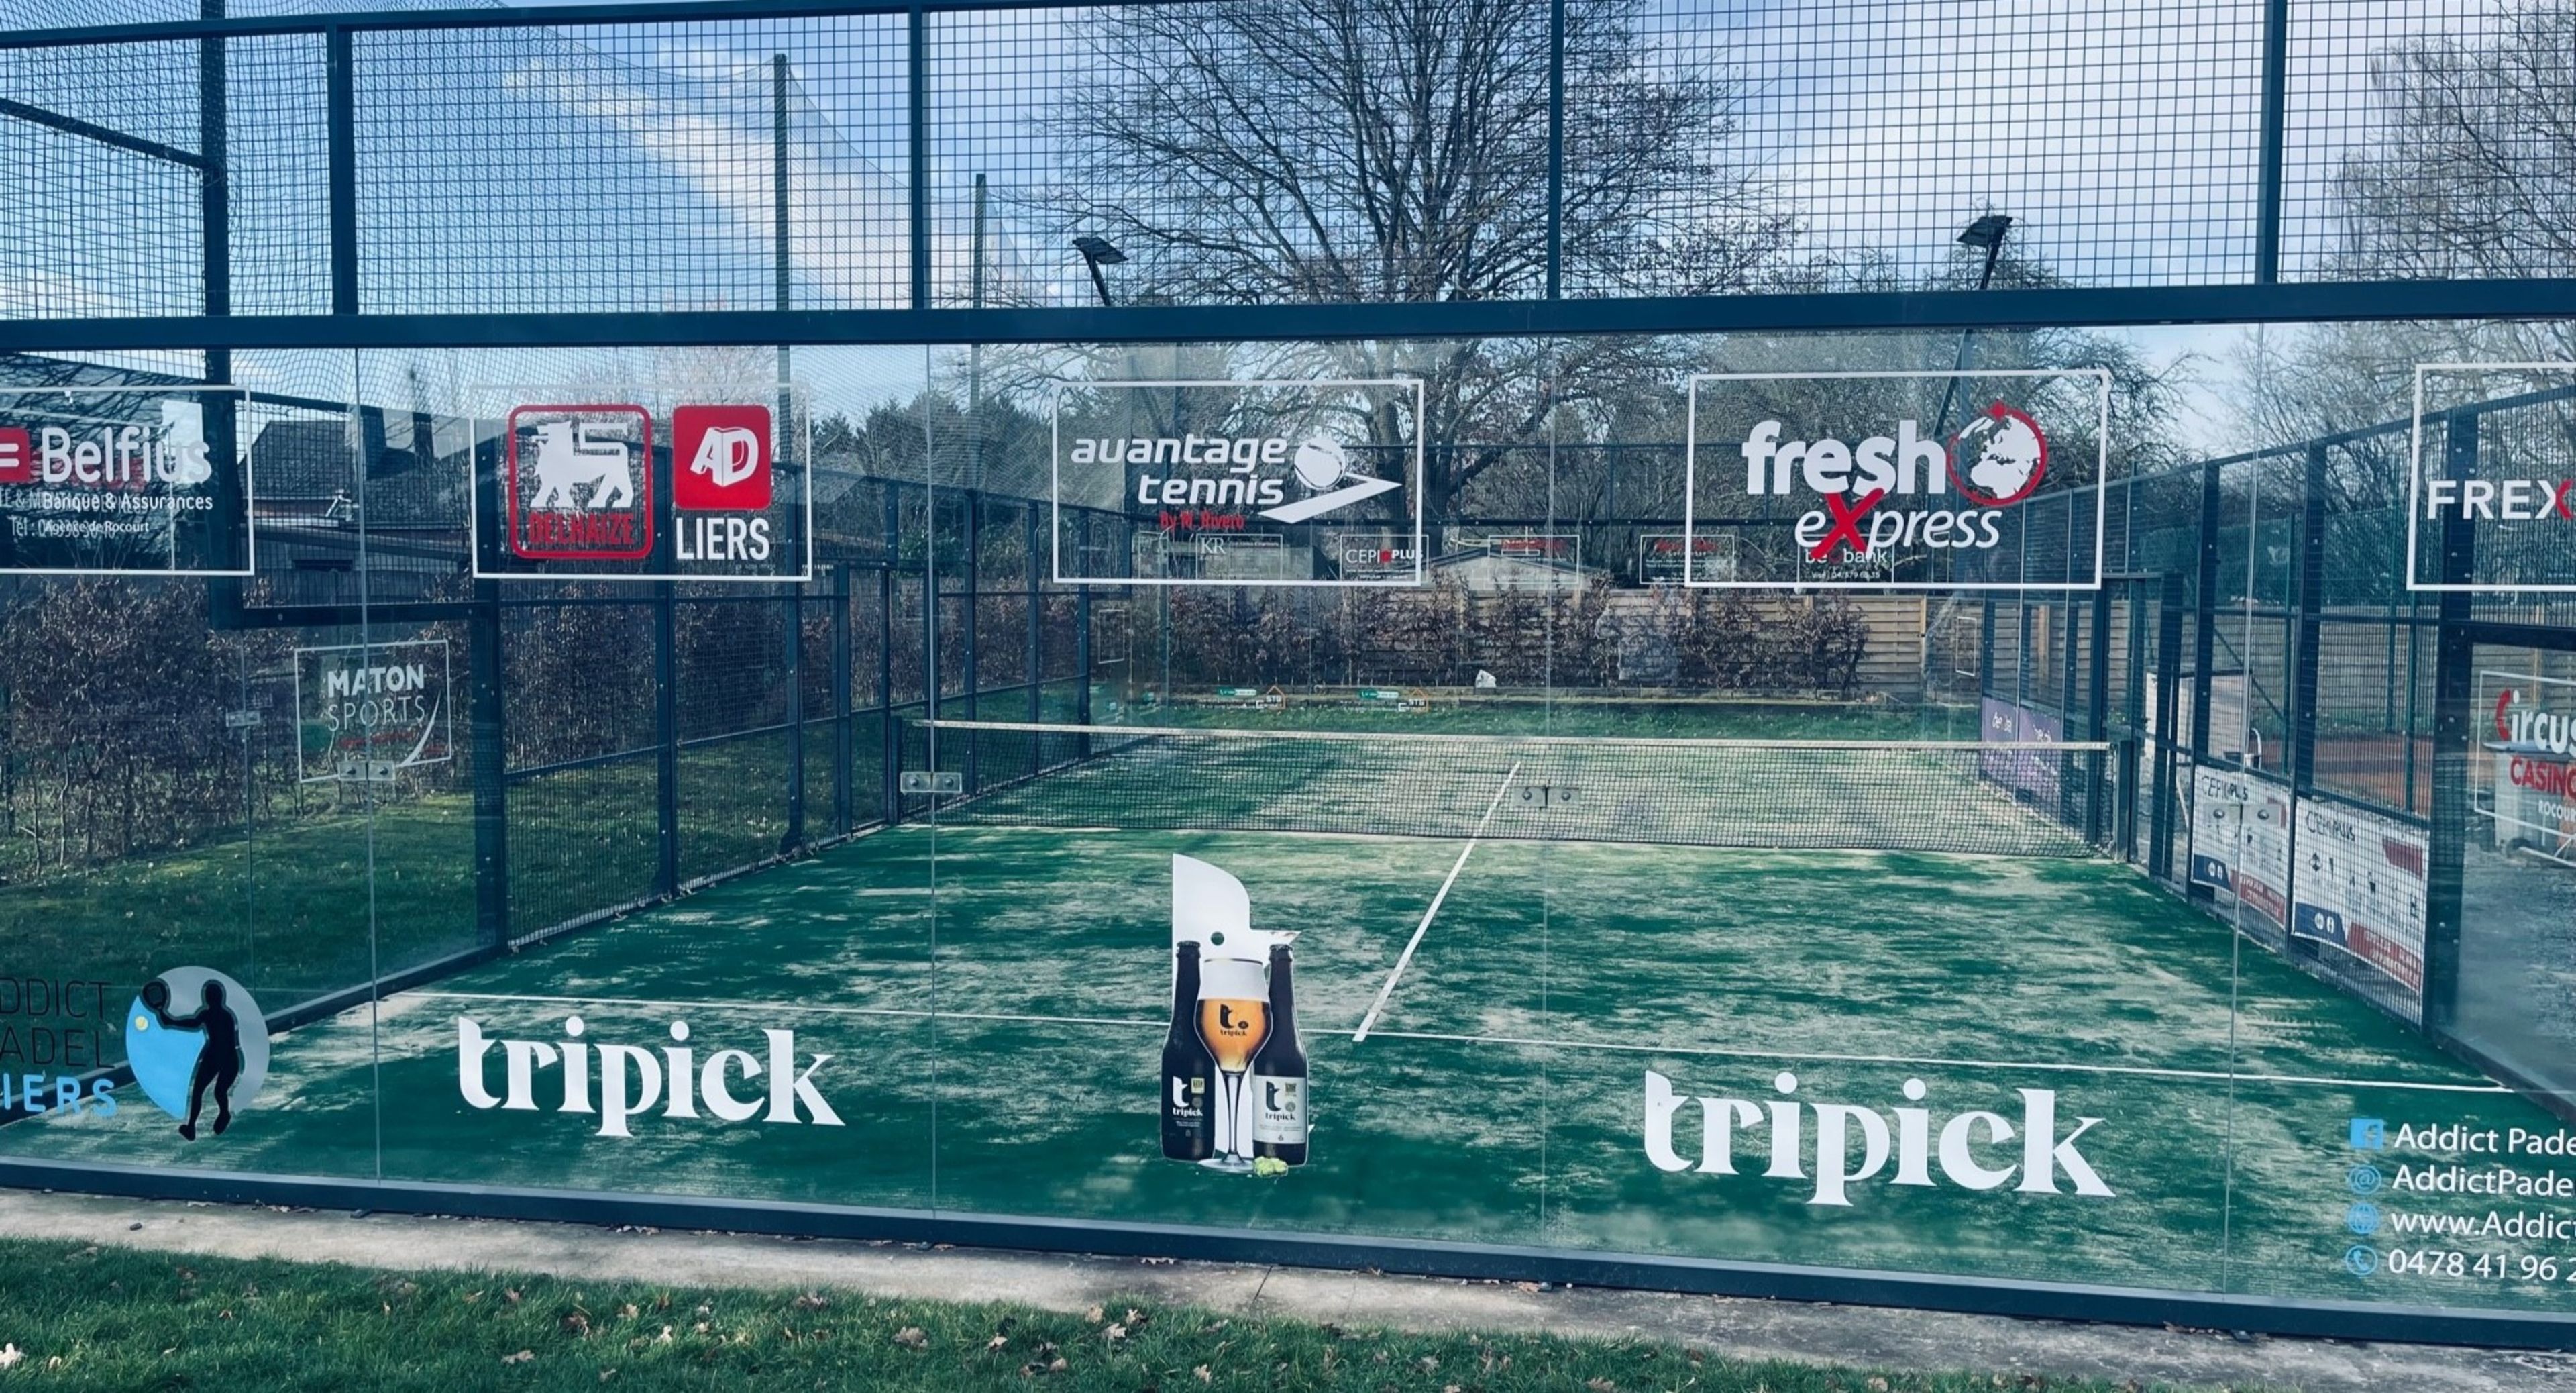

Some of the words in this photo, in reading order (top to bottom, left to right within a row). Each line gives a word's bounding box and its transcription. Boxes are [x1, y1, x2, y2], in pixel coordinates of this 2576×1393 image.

[42, 426, 213, 483] Belfius
[690, 426, 759, 487] AD
[1742, 419, 1946, 497] fresh
[42, 491, 101, 513] Banque
[105, 492, 116, 509] &
[121, 492, 213, 510] Assurances
[1138, 474, 1284, 505] tennis
[44, 521, 86, 535] Agence
[89, 521, 103, 533] de
[105, 521, 150, 533] Rocourt
[529, 511, 634, 544] DELHAIZE
[676, 517, 770, 560] LIERS
[1201, 537, 1226, 554] KR
[327, 664, 425, 699] MATON
[327, 695, 425, 732] SPORTS
[0, 1026, 115, 1068] ADEL
[458, 1015, 847, 1137] tripick
[3, 1072, 117, 1117] IERS
[1173, 1106, 1204, 1117] tripick
[1265, 1112, 1296, 1121] tripick
[1645, 1070, 2117, 1206] tripick
[2394, 1123, 2499, 1153] Addict
[2508, 1128, 2576, 1156] Pade
[2392, 1164, 2573, 1197] AddictPade
[2391, 1210, 2576, 1240] www.Addic
[2388, 1249, 2465, 1277] 0478
[2473, 1253, 2506, 1279] 41
[2520, 1255, 2558, 1282] 96
